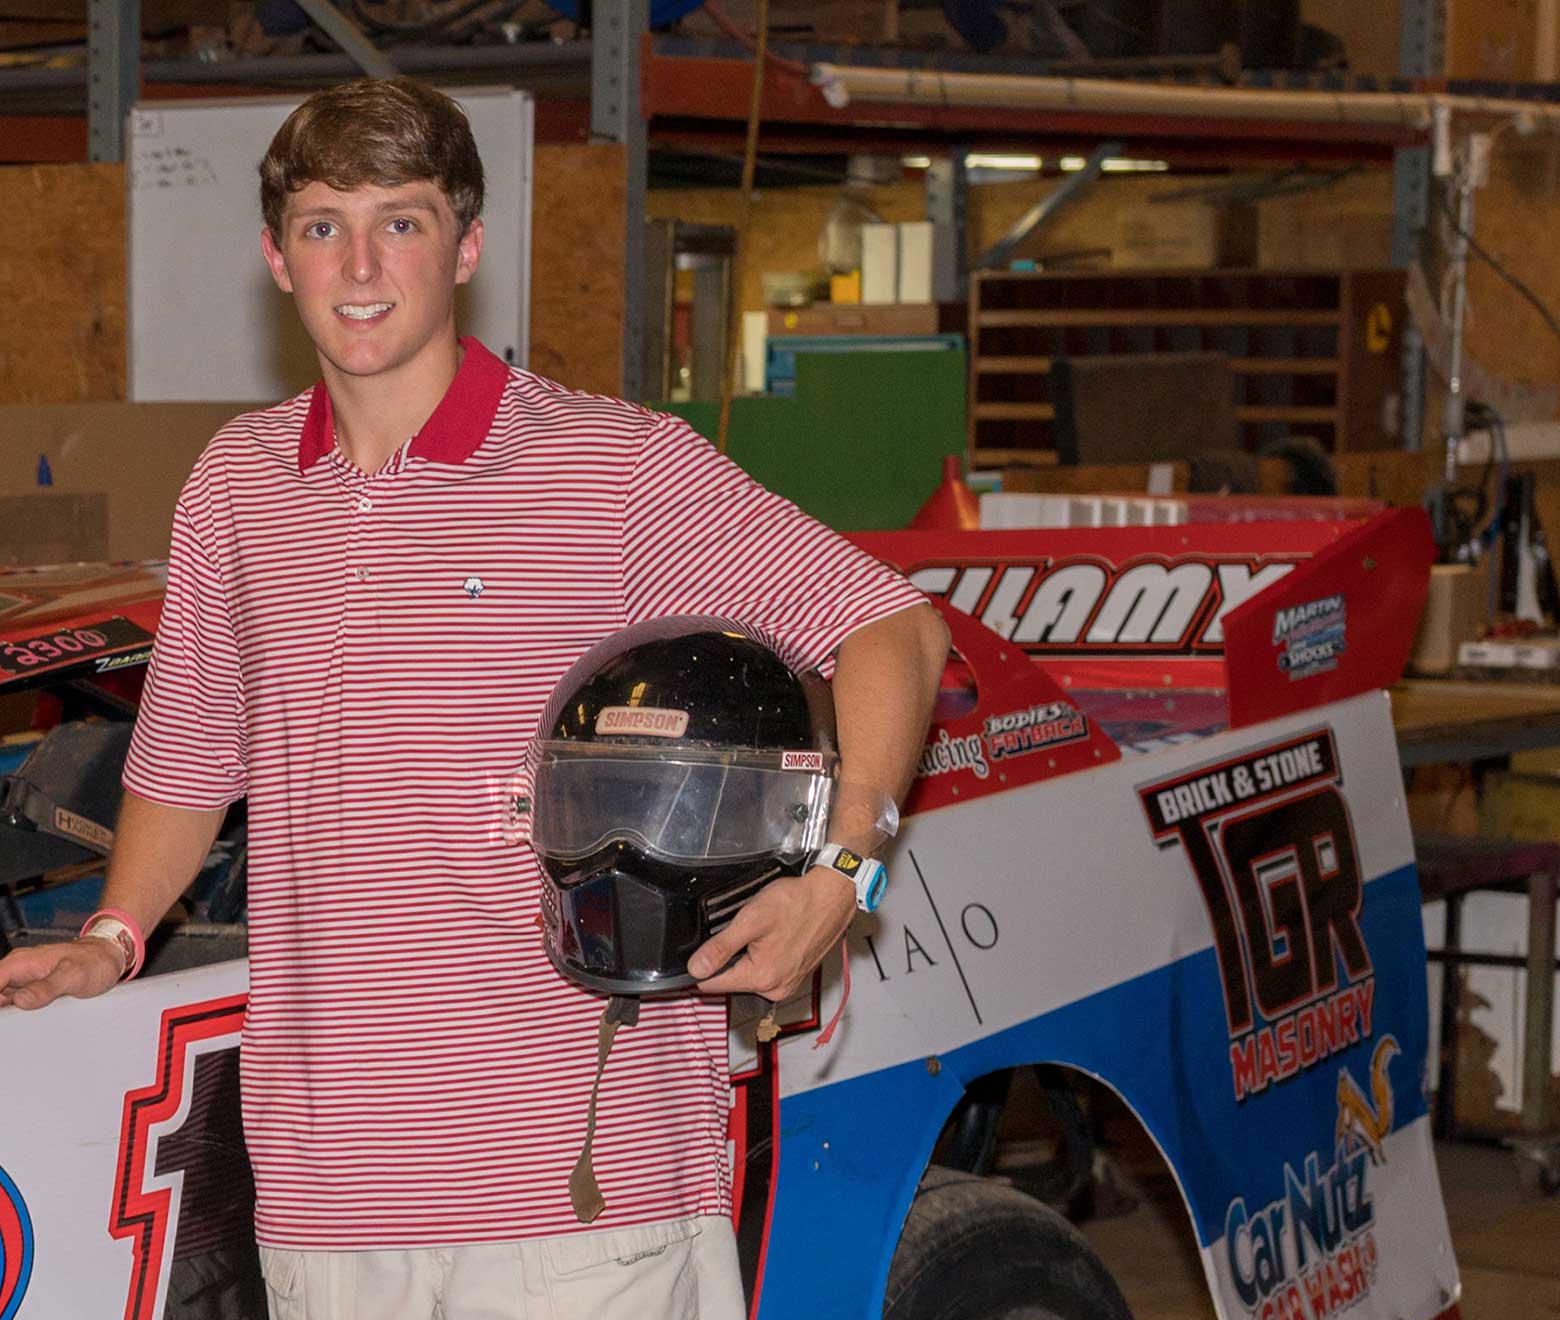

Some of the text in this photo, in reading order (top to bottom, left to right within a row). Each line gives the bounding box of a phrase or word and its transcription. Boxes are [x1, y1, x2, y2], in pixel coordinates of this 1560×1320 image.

[4, 630, 106, 666] 2300
[604, 710, 680, 731] SIMPSON
[989, 702, 1063, 734] BODIES
[990, 716, 1086, 757] FATBACK
[784, 752, 821, 768] SIMPSON
[918, 727, 989, 780] acing
[1157, 742, 1324, 824] BRICK & STONE
[1230, 980, 1376, 1099] MASONRY
[1224, 1150, 1375, 1309] Car Nutz
